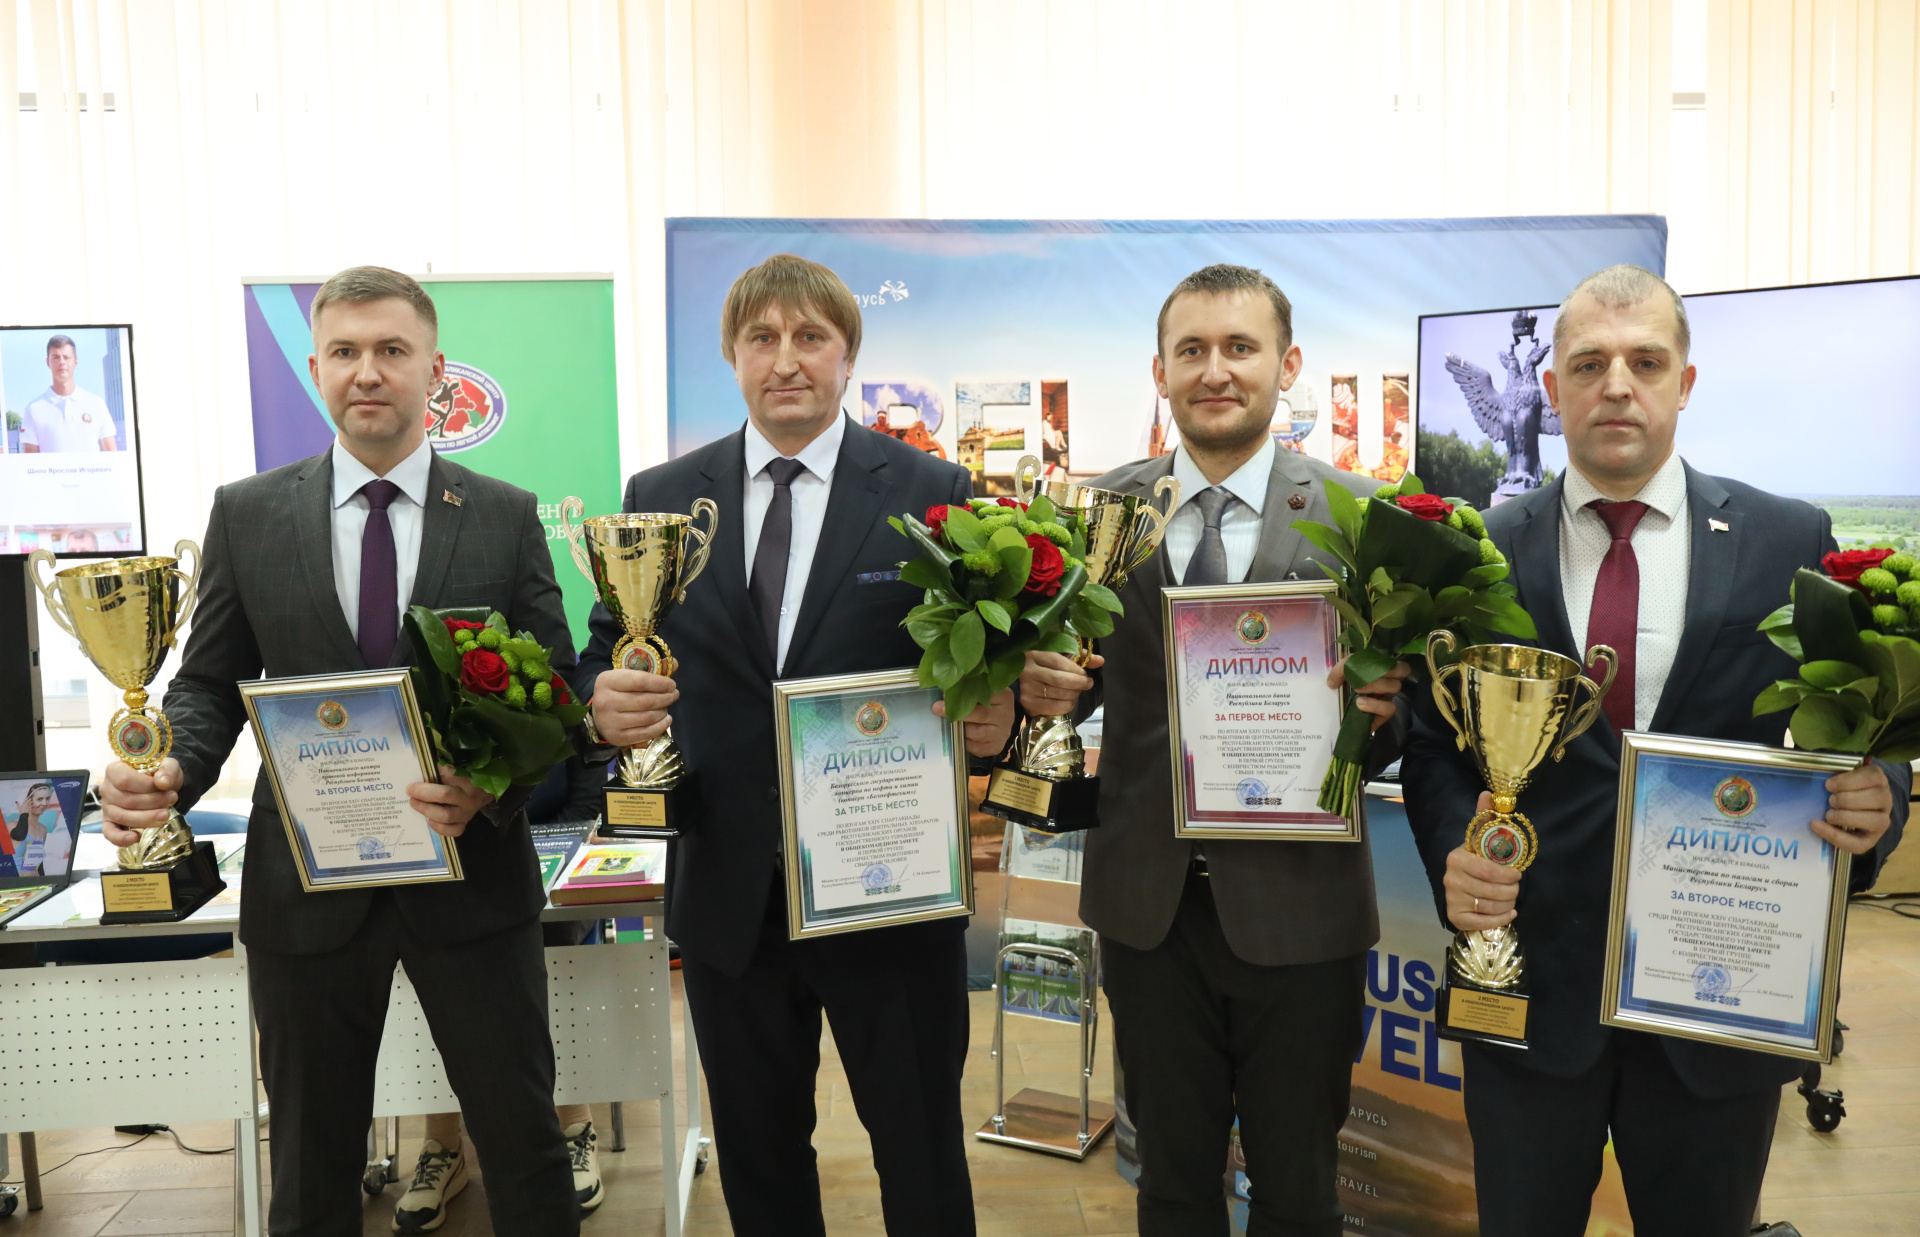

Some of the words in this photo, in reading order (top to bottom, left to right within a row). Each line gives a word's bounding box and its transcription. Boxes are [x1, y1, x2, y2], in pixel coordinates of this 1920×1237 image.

[48, 467, 78, 476] Ярослав
[79, 466, 112, 475] Игоревич
[1206, 656, 1308, 679] ДИПЛОМ
[1214, 713, 1225, 721] ЗА
[1228, 713, 1265, 721] ПЕРВОЕ
[1268, 712, 1301, 720] МЕСТО
[299, 736, 390, 761] ДИПЛОМ
[823, 743, 925, 774] ДИПЛОМ
[327, 785, 361, 794] ВТОРОЕ
[362, 782, 393, 791] МЕСТО
[834, 807, 846, 816] ЗА
[848, 803, 882, 814] ТРЕТЬЕ
[885, 798, 918, 809] МЕСТО
[1666, 825, 1798, 860] ДИПЛОМ
[1661, 863, 1718, 877] Министерства
[1771, 878, 1799, 888] сборам
[1689, 876, 1731, 888] Республики
[1734, 882, 1767, 893] Беларусь
[1670, 889, 1685, 900] ЗА
[1688, 892, 1734, 907] ВТОРОЕ
[1738, 898, 1781, 913] МЕСТО
[1481, 996, 1500, 1004] МЕСТО
[1337, 1140, 1377, 1160] tourism
